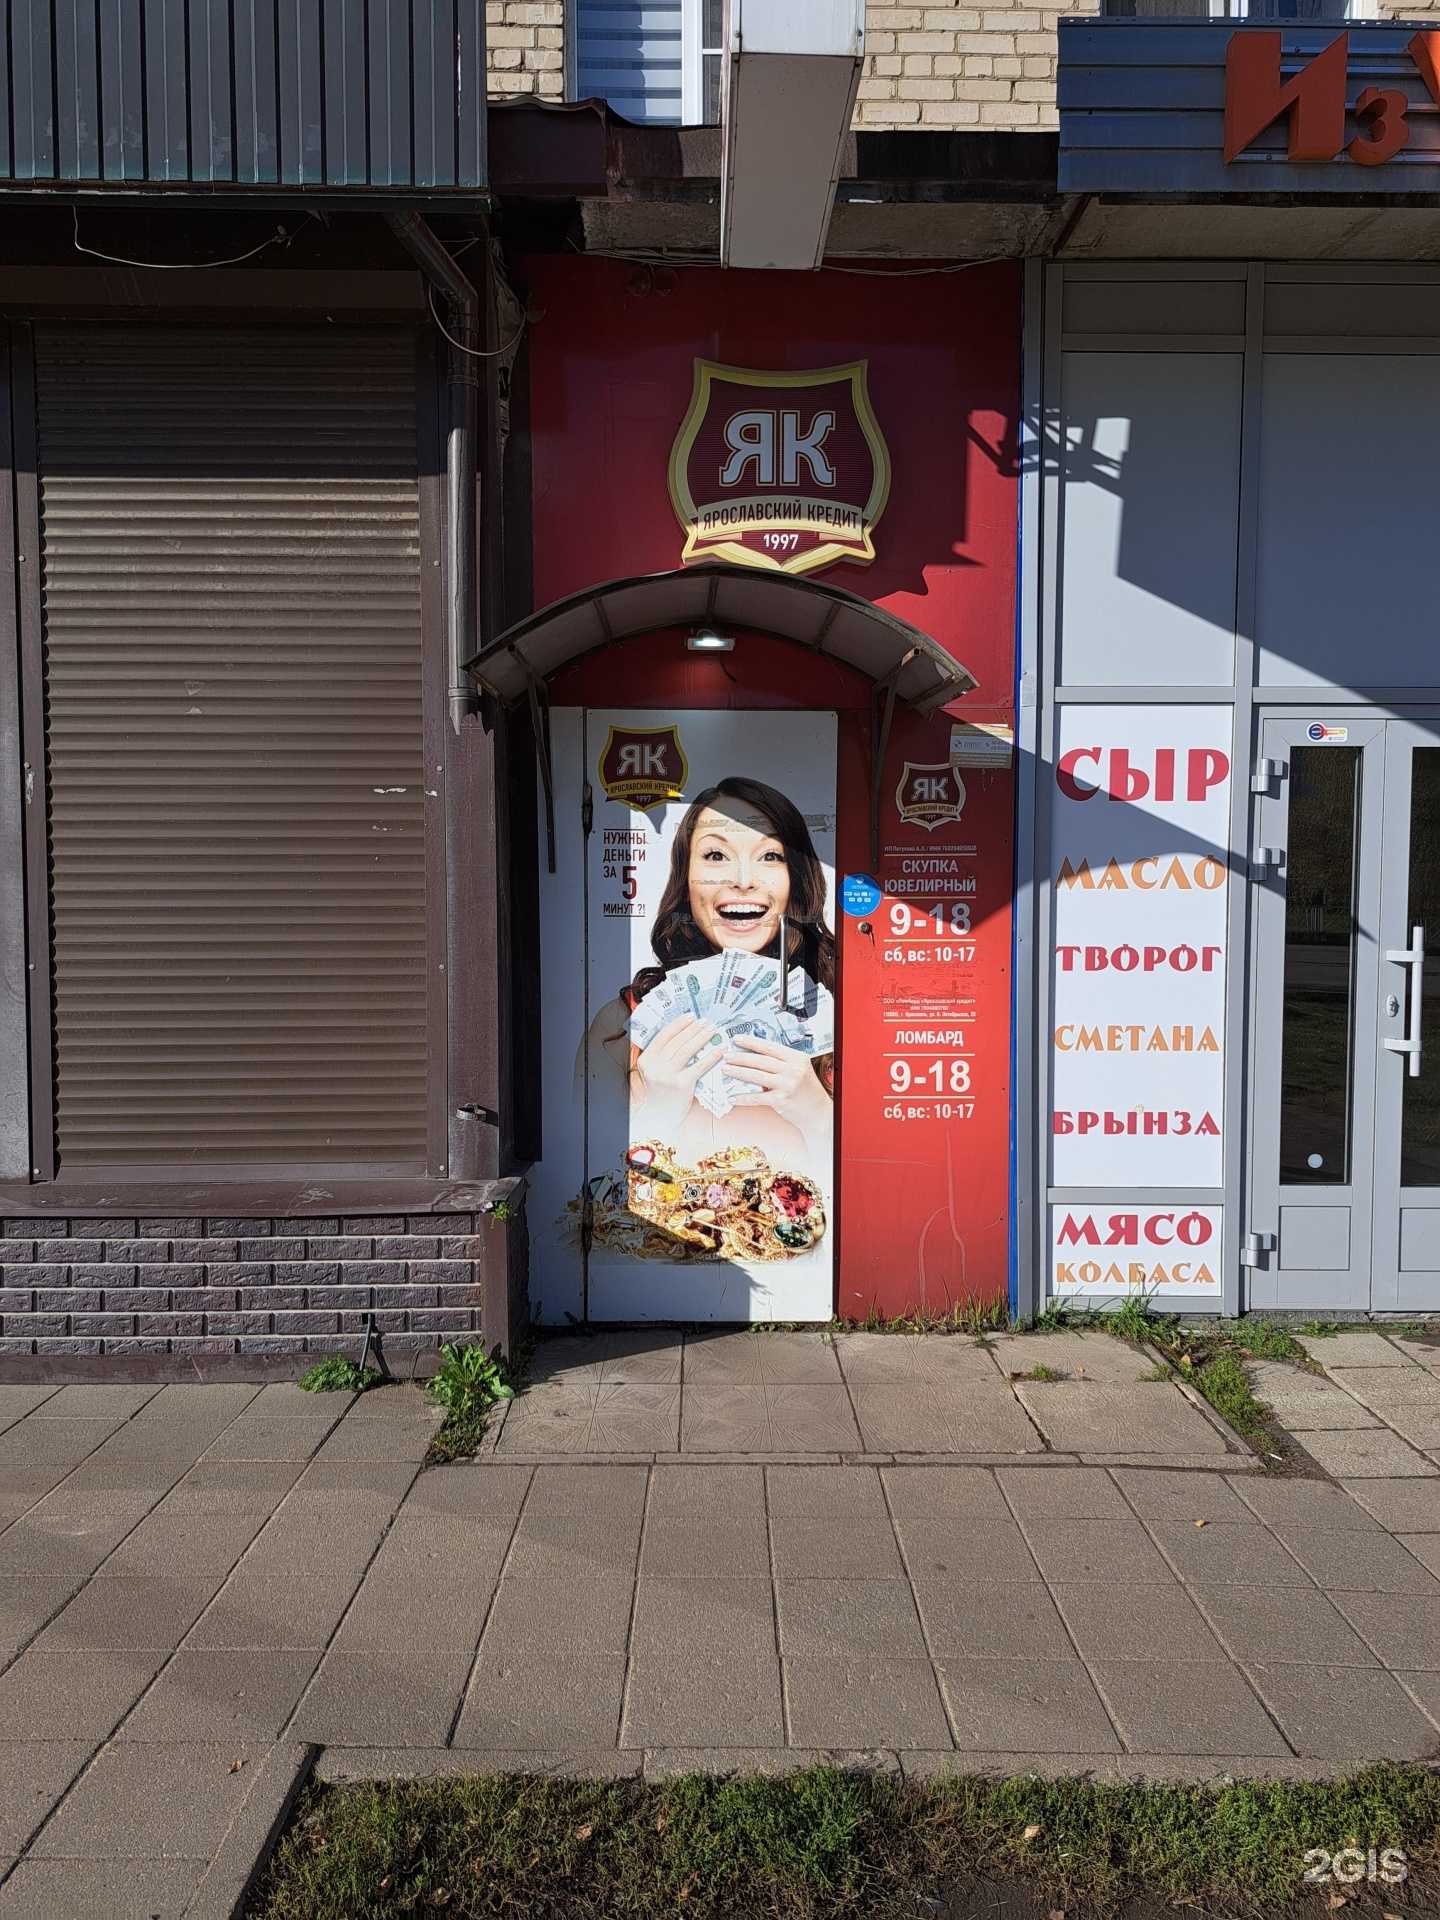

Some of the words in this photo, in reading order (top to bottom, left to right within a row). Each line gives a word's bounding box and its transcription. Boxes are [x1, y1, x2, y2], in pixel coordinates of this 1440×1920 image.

[719, 410, 836, 487] ЯК
[703, 499, 802, 531] ЯРОСЛАВСКИЙ
[806, 505, 859, 530] КРЕДИТ
[763, 533, 799, 550] 1997
[617, 743, 668, 776] ЯК
[1056, 747, 1230, 802] СЫР
[912, 777, 949, 801] ЯК
[603, 832, 646, 845] НУЖНЫ
[602, 849, 646, 864] ДЕНЬГИ
[902, 859, 959, 874] СКУПКА
[603, 866, 617, 879] ЗА
[622, 866, 637, 900] 5
[884, 876, 977, 893] ЮВЕЛИРНЫЙ
[1055, 855, 1227, 890] МАСЛО
[603, 904, 635, 915] МИНУТ
[890, 903, 971, 936] 9-18
[934, 946, 976, 962] 10-17
[1055, 944, 1221, 972] ТВОРОГ
[895, 1030, 964, 1047] ЛОМБАРД
[1055, 1024, 1220, 1051] СМЕТАНА
[889, 1060, 971, 1093] 9-18
[934, 1103, 974, 1119] 10-17
[1053, 1111, 1221, 1135] БРЫНЗА
[1056, 1212, 1212, 1246] МЯСО
[1056, 1261, 1216, 1284] КОЛБАСА
